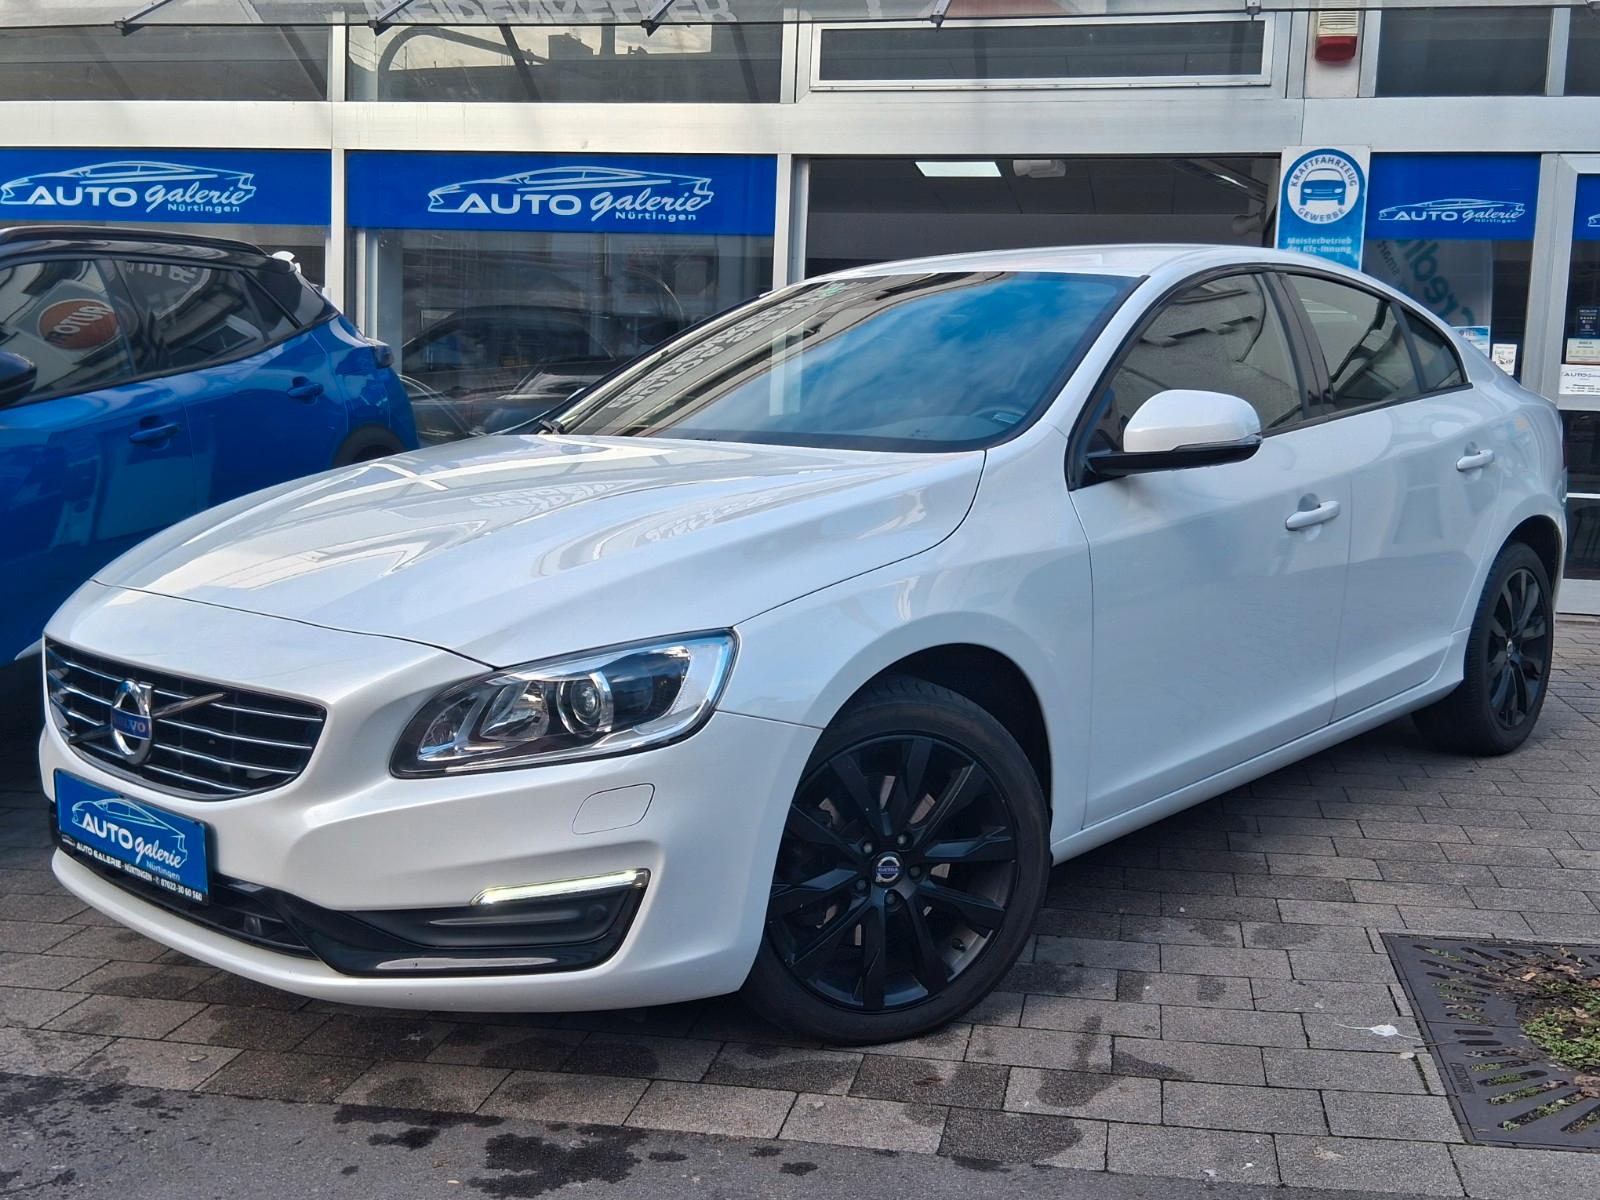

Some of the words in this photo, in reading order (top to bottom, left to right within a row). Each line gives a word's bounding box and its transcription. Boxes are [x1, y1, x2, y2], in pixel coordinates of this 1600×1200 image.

[1291, 156, 1358, 187] KRAFTFAHRZEUG
[27, 186, 138, 207] AUTO
[144, 181, 248, 213] galerie
[457, 192, 582, 216] AUTO
[590, 187, 704, 222] galerie
[167, 203, 240, 213] Nürtingen
[615, 211, 697, 222] Nürtingen
[1297, 207, 1346, 222] GEWERBE
[1393, 211, 1458, 221] AUTO
[1462, 208, 1519, 224] galerie
[1287, 236, 1352, 245] Meisterbetrieb
[82, 812, 133, 850] AUTO
[135, 836, 182, 869] galerie
[76, 842, 93, 856] AUTO
[94, 850, 122, 868] GALERIE
[146, 860, 181, 881] Nürtingen
